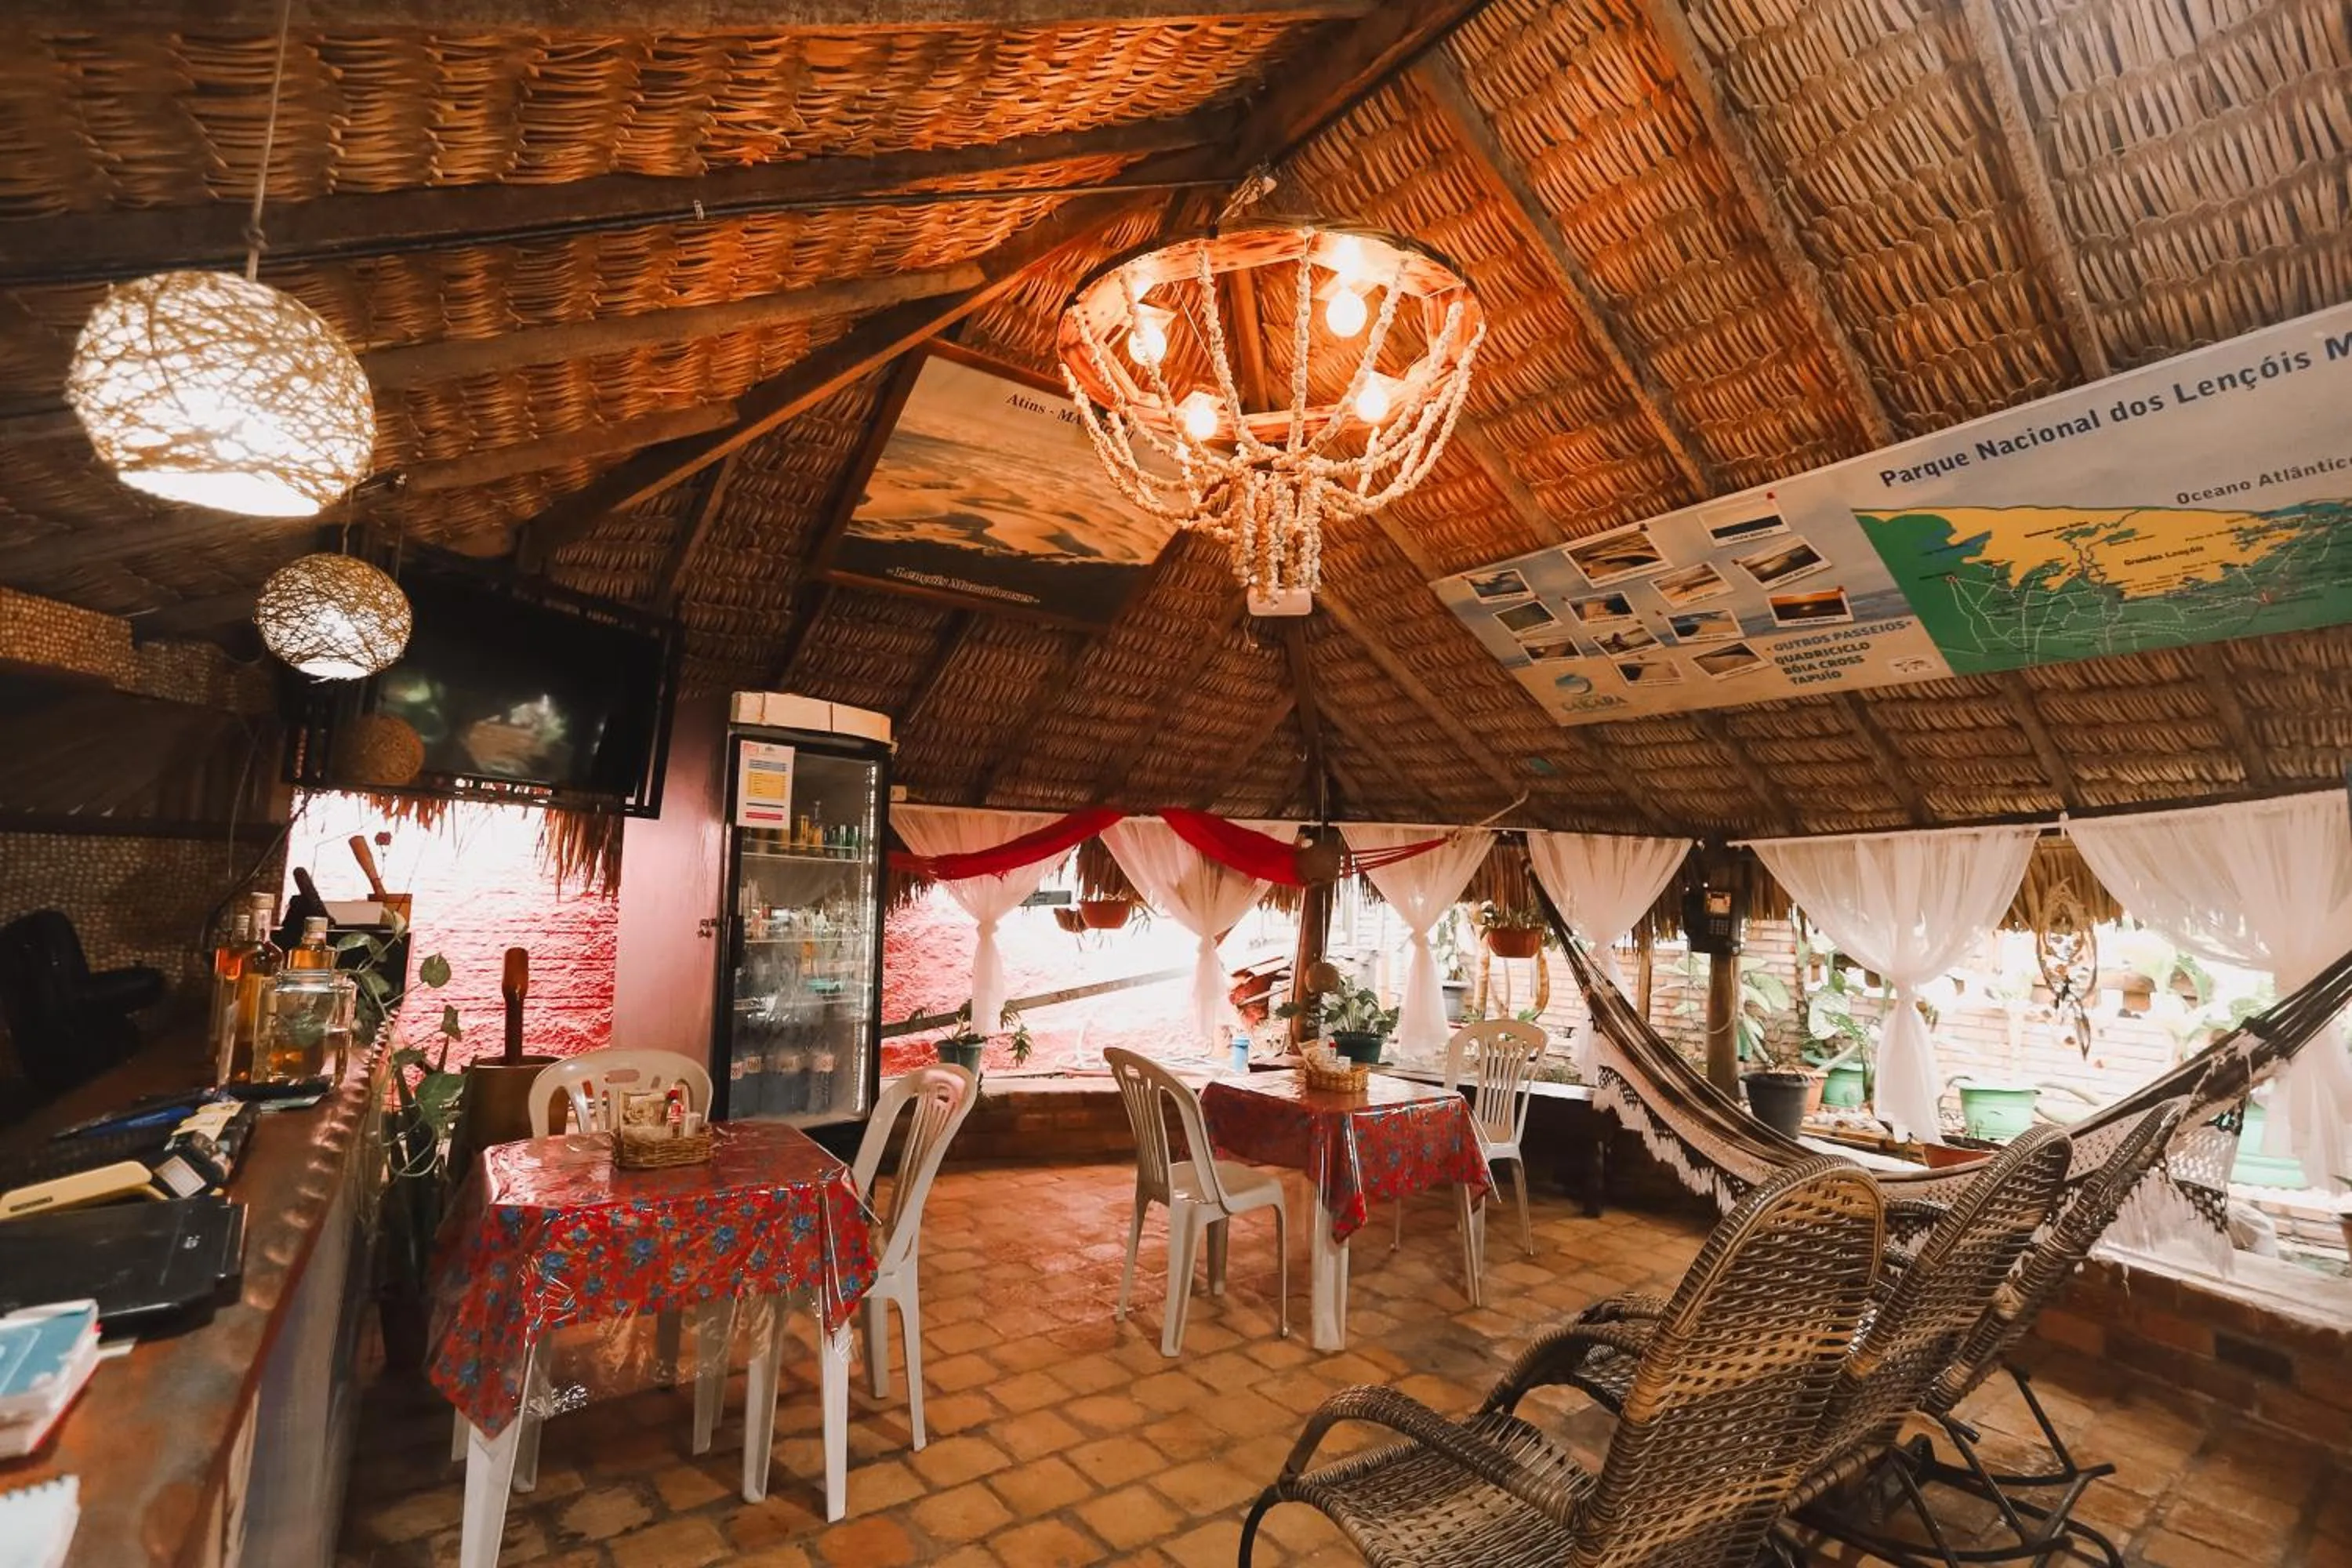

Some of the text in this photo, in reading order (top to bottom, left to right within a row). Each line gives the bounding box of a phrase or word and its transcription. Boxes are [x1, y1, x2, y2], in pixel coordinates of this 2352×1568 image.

[1007, 394, 1047, 415] Atins
[1880, 452, 1970, 488] Parque
[1975, 409, 2101, 461] Nacional
[2110, 394, 2164, 423] dos
[2173, 351, 2311, 405] Lençóis
[2176, 480, 2251, 505] Oceano
[1773, 635, 1831, 652] OUTROS
[1831, 620, 1905, 641] PASSEIOS
[1774, 641, 1871, 665] QUADRICICLO
[1818, 655, 1865, 670] CROSS
